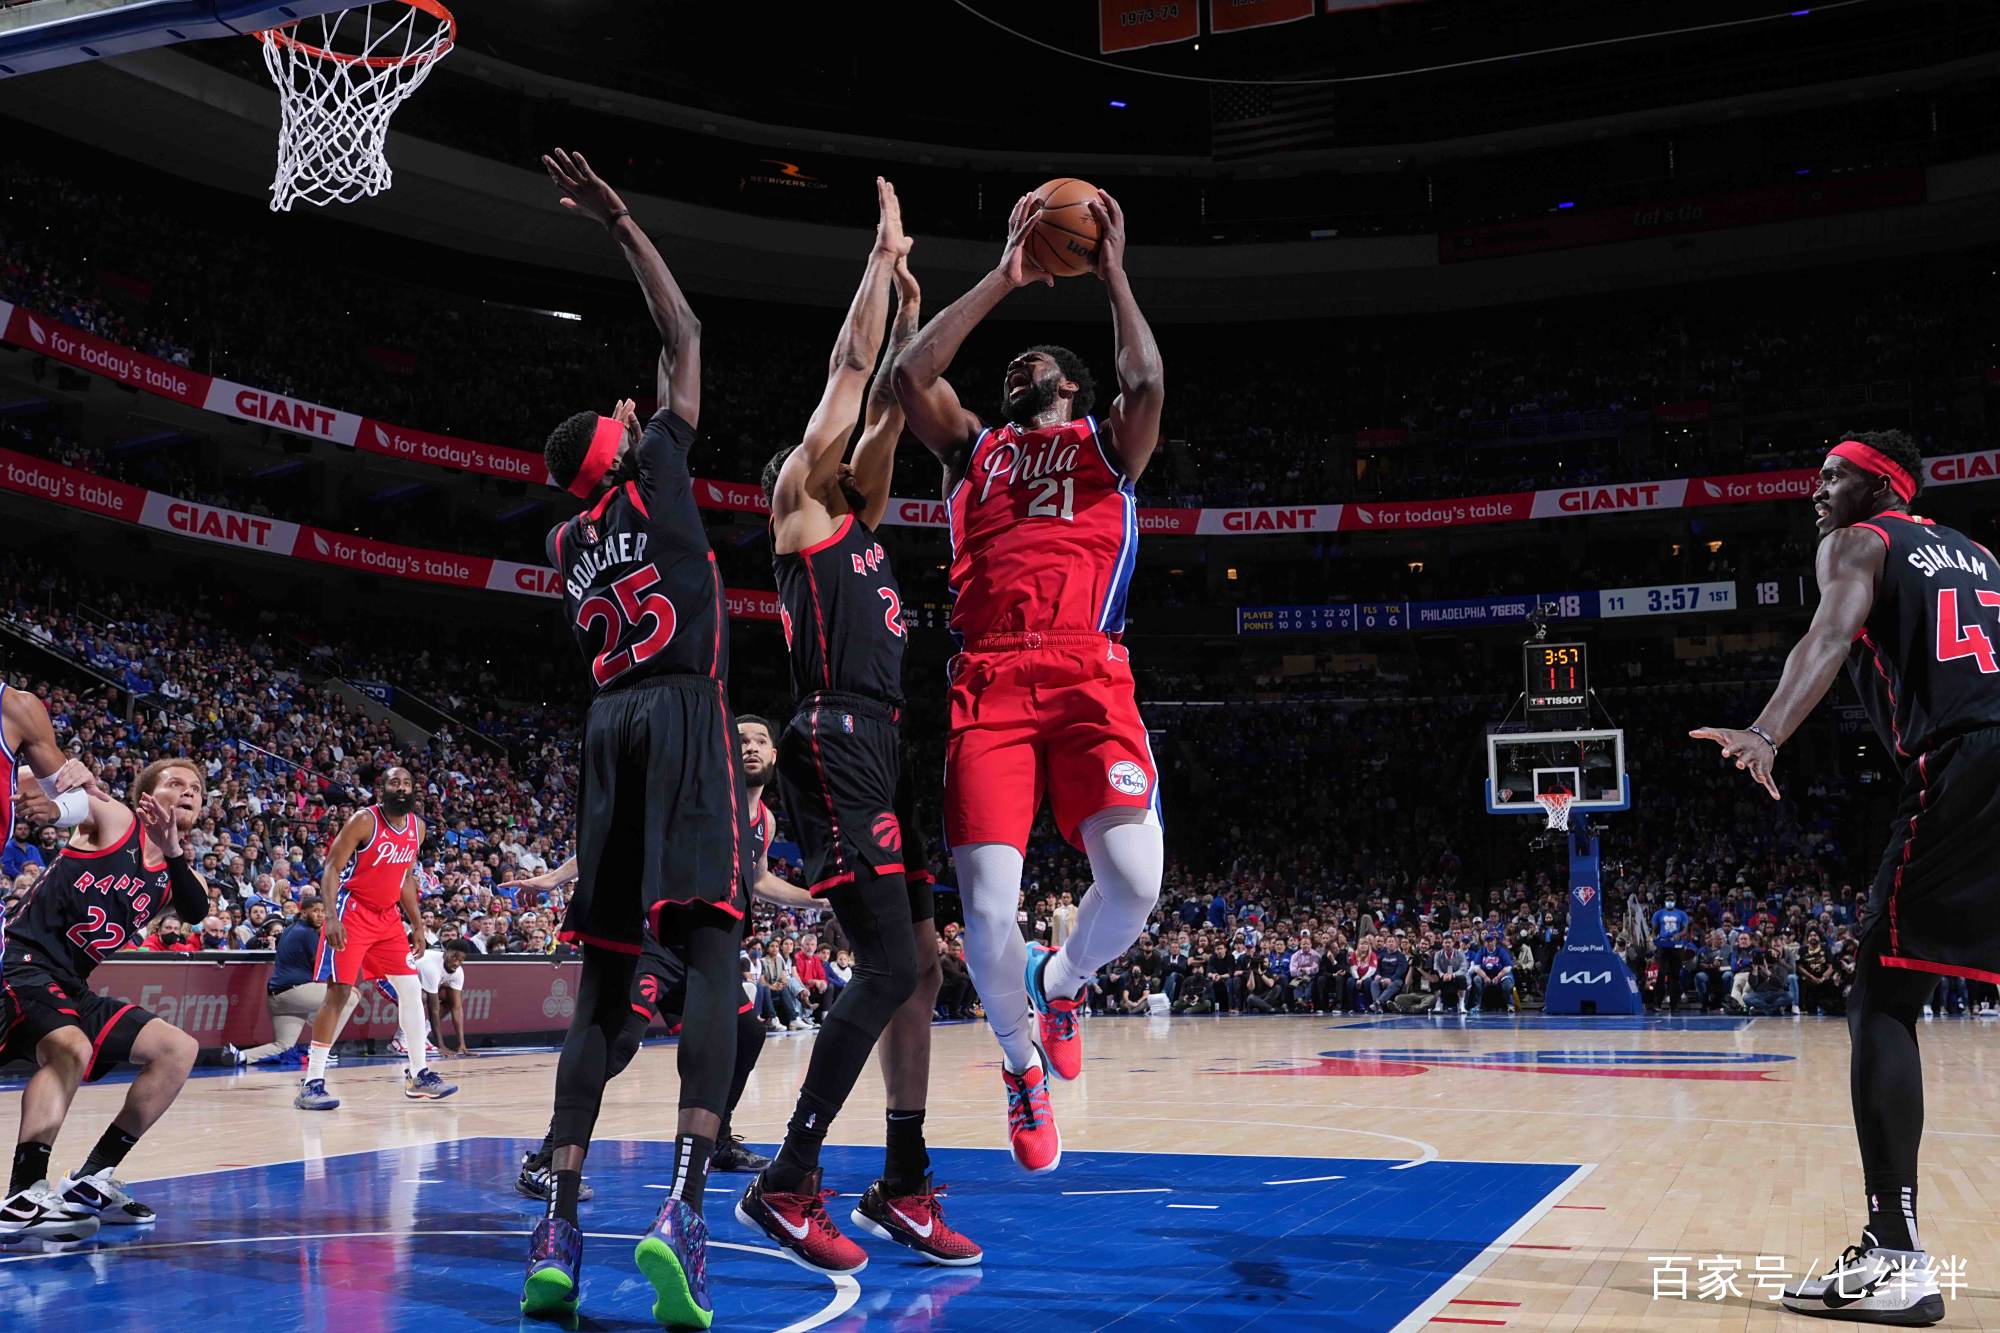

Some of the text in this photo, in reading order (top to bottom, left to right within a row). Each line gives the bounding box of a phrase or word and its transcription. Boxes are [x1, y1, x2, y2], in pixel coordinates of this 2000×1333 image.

[1120, 4, 1180, 27] 1973-74
[51, 332, 187, 395] for today's table
[235, 390, 336, 437] GIANT
[394, 434, 531, 476] for today's table
[980, 434, 1080, 504] Phila
[1930, 457, 2000, 482] GIA
[7, 463, 124, 511] today's table
[727, 490, 752, 506] for
[1027, 477, 1074, 522] 21
[1558, 484, 1660, 512] GIANT
[1727, 479, 1752, 497] for
[167, 503, 272, 546] GIANT
[900, 503, 950, 524] GIA
[1139, 515, 1180, 529] table
[1222, 509, 1317, 531] GIANT
[1378, 501, 1513, 524] for today's table
[334, 542, 470, 580] for today's table
[567, 532, 648, 600] BOUCHER
[1907, 544, 1988, 581] SIAKAM
[512, 567, 563, 594] GIA
[1420, 595, 1580, 622] PHILADELPHIA 76ERS 18
[1608, 582, 1780, 612] 11 3:57 1ST 18
[576, 562, 677, 688] 25
[877, 586, 906, 637] 2
[904, 619, 920, 628] OR
[1243, 611, 1274, 620] PLAYER
[1278, 610, 1289, 619] 21
[1295, 610, 1302, 618] 0
[1324, 609, 1334, 617] 22
[1339, 608, 1350, 617] 20
[1243, 622, 1274, 631] POINTS
[1279, 621, 1289, 630] 10
[1295, 620, 1302, 629] 0
[1326, 620, 1333, 628] 0
[1341, 619, 1348, 628] 0
[1366, 615, 1397, 628] 0 6
[1545, 648, 1579, 665] 3:57
[1550, 667, 1575, 690] 11
[1545, 695, 1585, 705] TISSOT
[372, 841, 415, 867] Phila
[73, 870, 151, 929] RAPTOR
[66, 905, 126, 965] 22
[1567, 944, 1589, 953] Google
[1559, 970, 1612, 985] KIA
[141, 984, 229, 1032] Farm
[353, 982, 400, 1025] Sta
